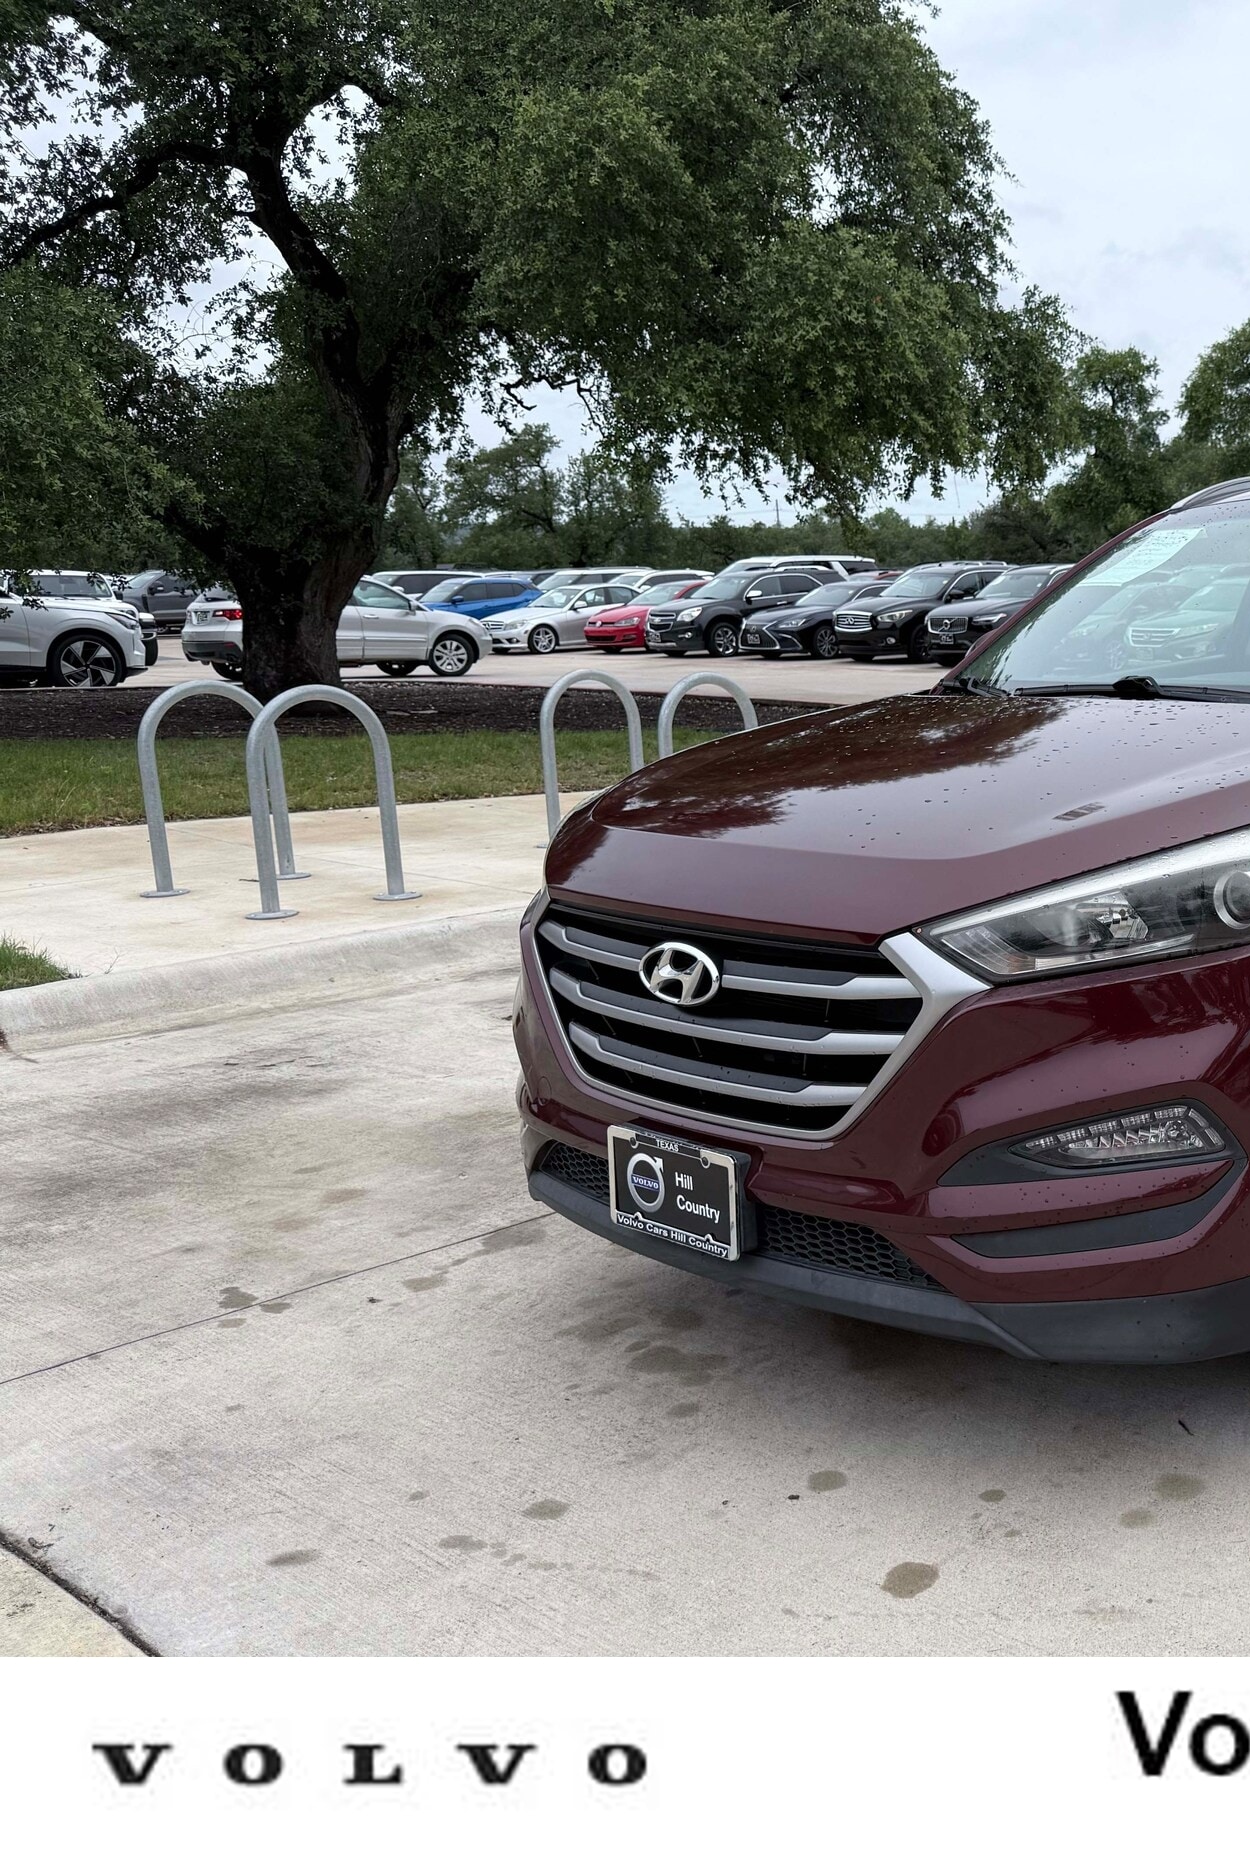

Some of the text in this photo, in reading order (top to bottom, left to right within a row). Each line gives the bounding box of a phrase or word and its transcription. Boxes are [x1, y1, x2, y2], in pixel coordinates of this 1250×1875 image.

[656, 1139, 679, 1152] TEXAS
[632, 1175, 660, 1190] VOLVO
[675, 1171, 694, 1191] Hill
[676, 1194, 721, 1224] Country
[617, 1214, 728, 1257] Volvo Cars Hill Country
